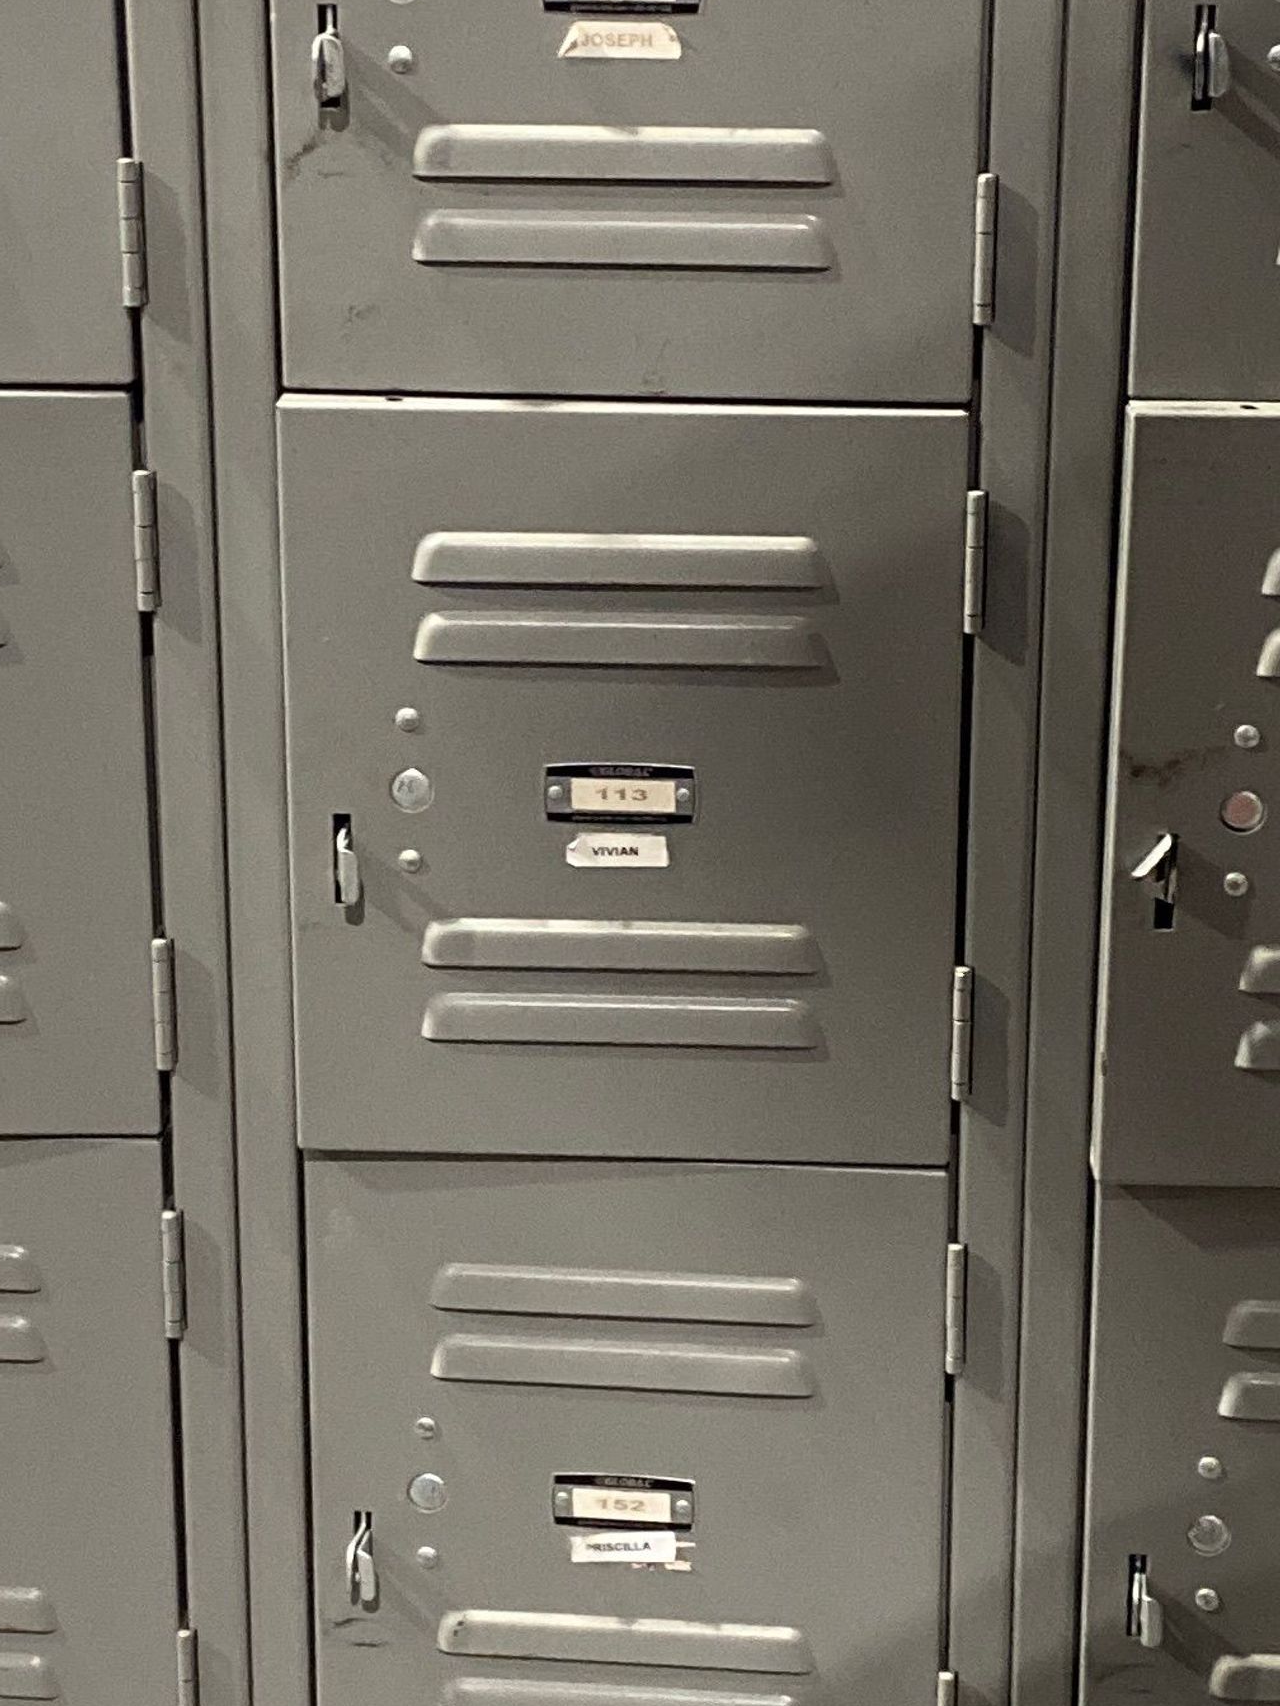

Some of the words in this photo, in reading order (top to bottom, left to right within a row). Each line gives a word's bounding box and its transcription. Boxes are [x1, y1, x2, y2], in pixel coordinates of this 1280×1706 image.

[580, 32, 653, 47] JOSEPH
[595, 788, 648, 802] 113
[592, 846, 639, 857] VIVIAN
[595, 1498, 646, 1512] 152
[585, 1542, 652, 1553] PRISCILLA
